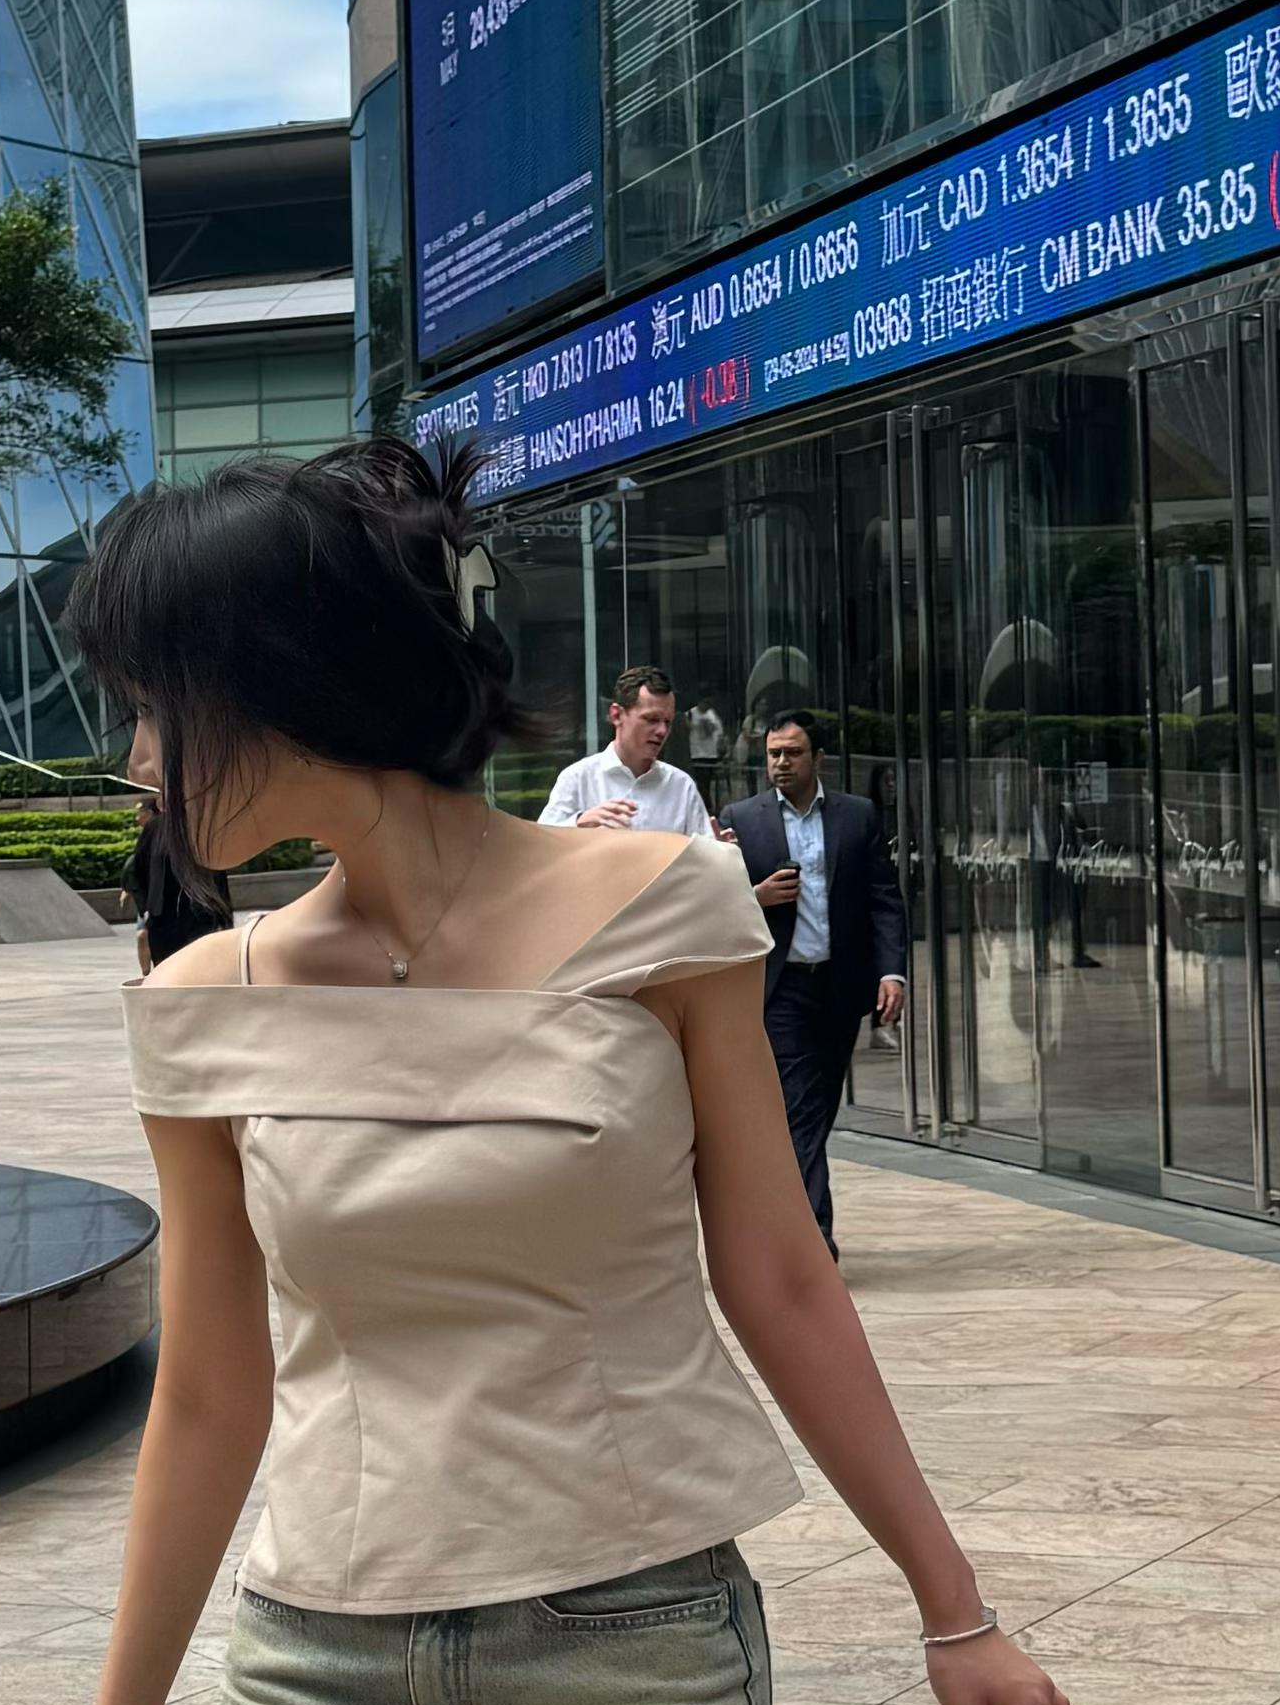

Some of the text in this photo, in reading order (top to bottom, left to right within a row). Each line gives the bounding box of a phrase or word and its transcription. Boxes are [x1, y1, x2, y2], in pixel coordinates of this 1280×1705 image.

[522, 361, 549, 404] HKD
[550, 344, 584, 392] 7.813
[594, 320, 638, 374] 7.8135
[690, 282, 724, 335] AUD
[729, 254, 782, 319] 0.6654
[799, 220, 859, 290] 0.6656
[879, 185, 933, 268] 加元
[937, 166, 988, 232] CAD
[996, 125, 1075, 206] 1.3654
[1102, 72, 1193, 162] 1.3655
[529, 417, 583, 471] HANSOH
[584, 395, 643, 452] PHARMA
[648, 377, 685, 429] 16.24
[853, 293, 912, 359] 03968
[919, 246, 1029, 346] 招商銀行
[1039, 228, 1081, 294] CM
[1086, 195, 1167, 278] BANK
[1176, 161, 1257, 246] 35.85
